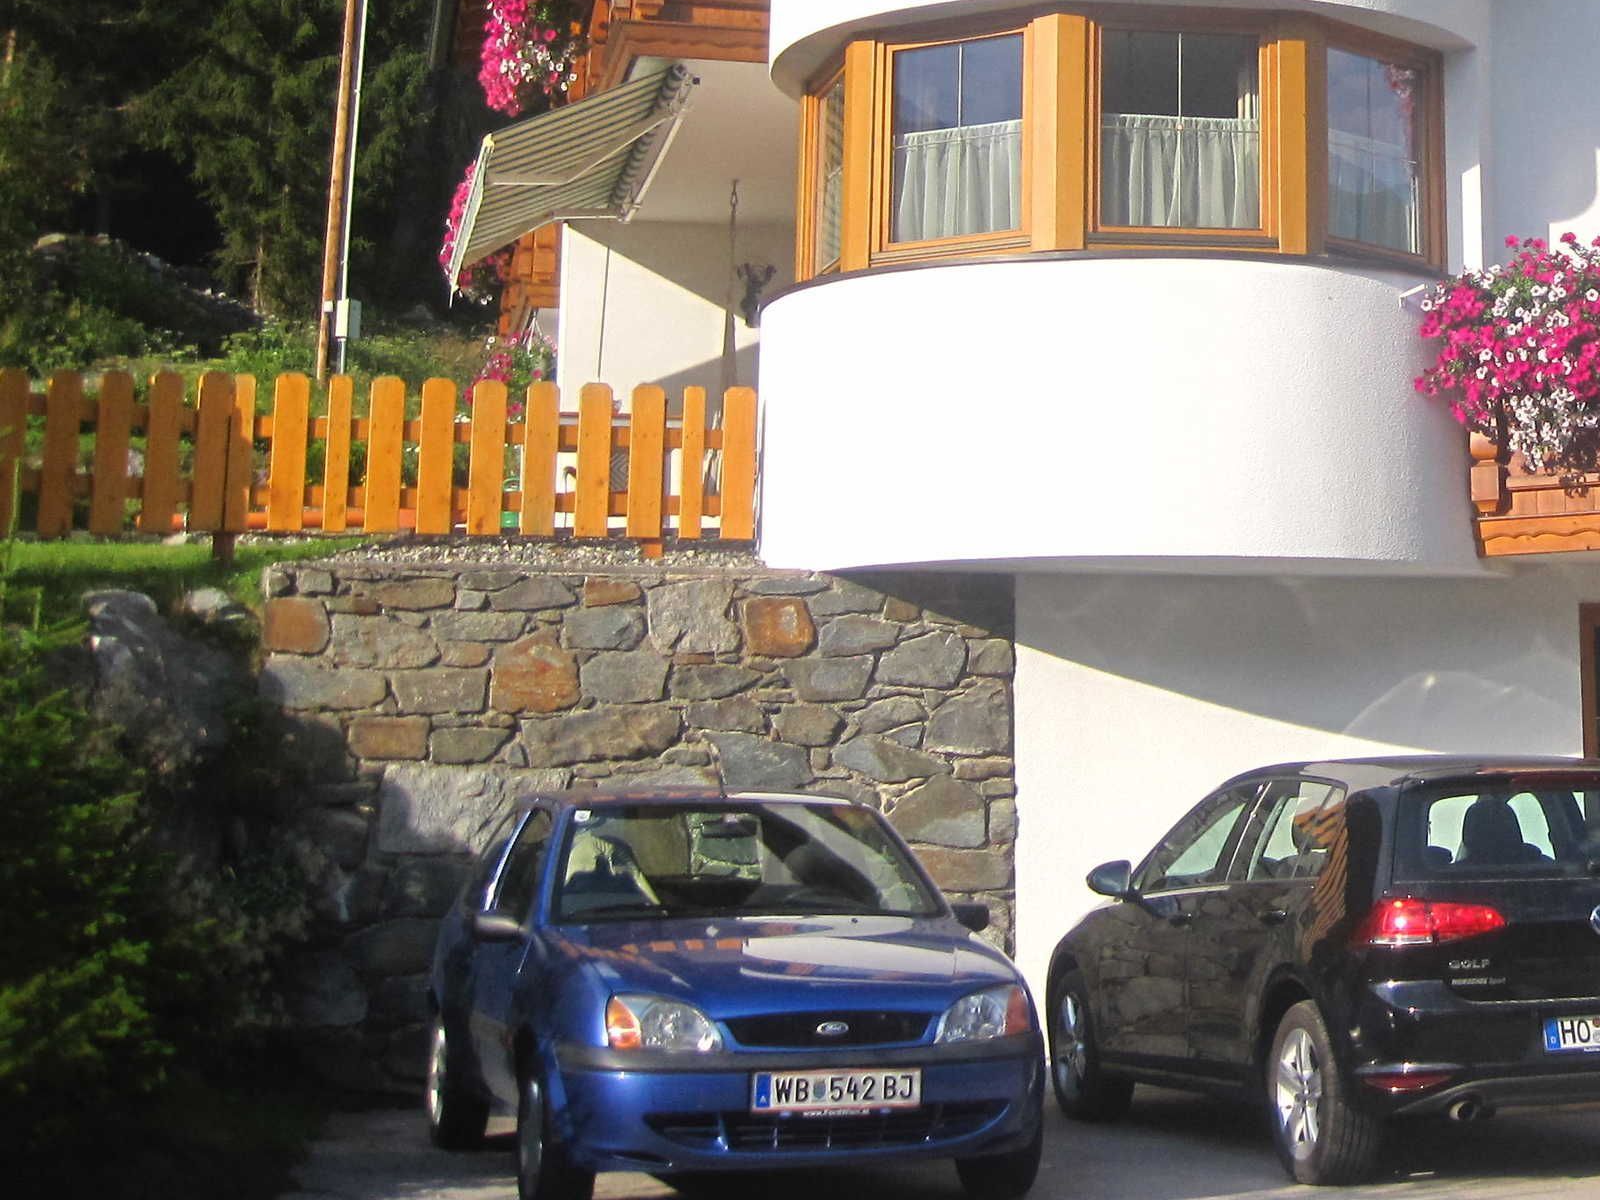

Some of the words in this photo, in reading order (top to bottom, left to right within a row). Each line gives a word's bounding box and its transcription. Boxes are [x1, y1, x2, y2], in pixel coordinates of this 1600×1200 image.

[1561, 1018, 1591, 1044] HO
[775, 1077, 809, 1104] WB
[830, 1076, 876, 1102] 542
[883, 1075, 913, 1100] BJ
